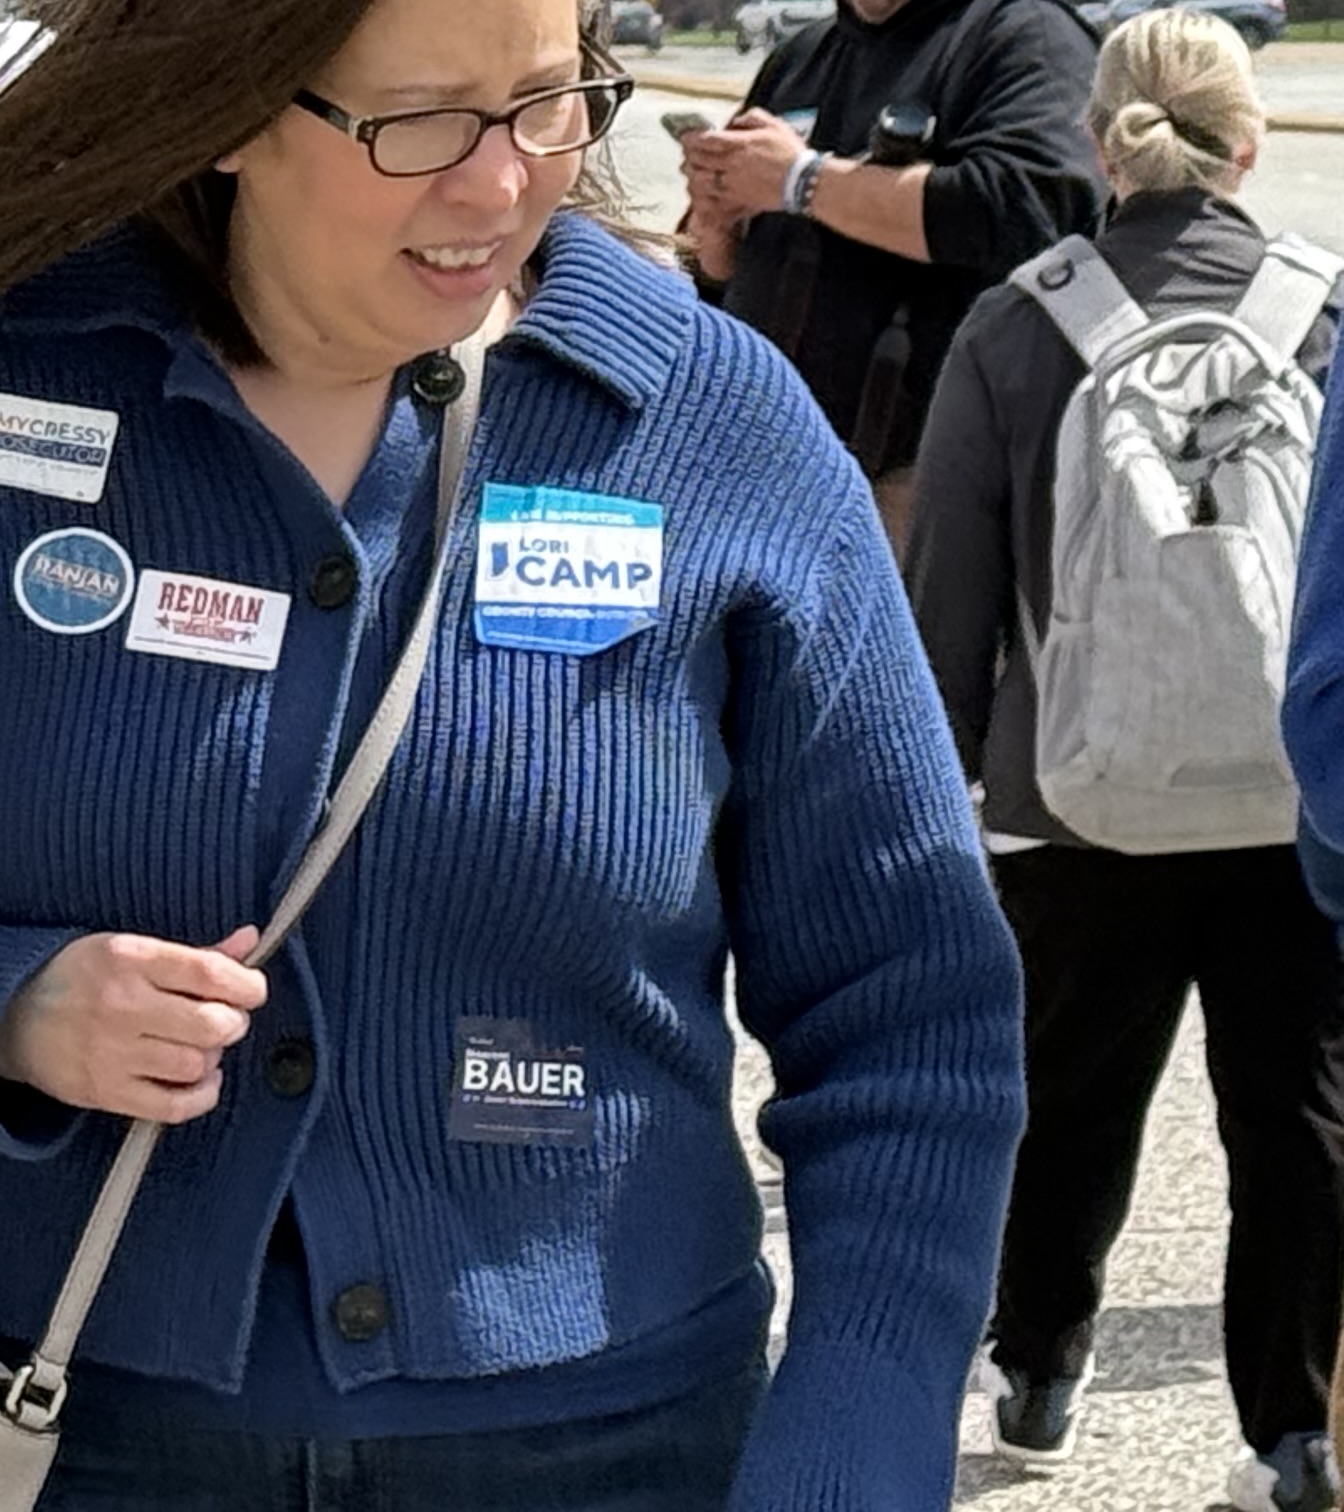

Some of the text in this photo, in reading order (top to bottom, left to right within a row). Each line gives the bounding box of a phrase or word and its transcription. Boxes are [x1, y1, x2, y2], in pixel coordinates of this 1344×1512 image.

[518, 536, 570, 554] LORI
[515, 555, 654, 591] CAMP
[157, 582, 265, 626] REDMAN
[462, 1058, 586, 1098] BAUER
